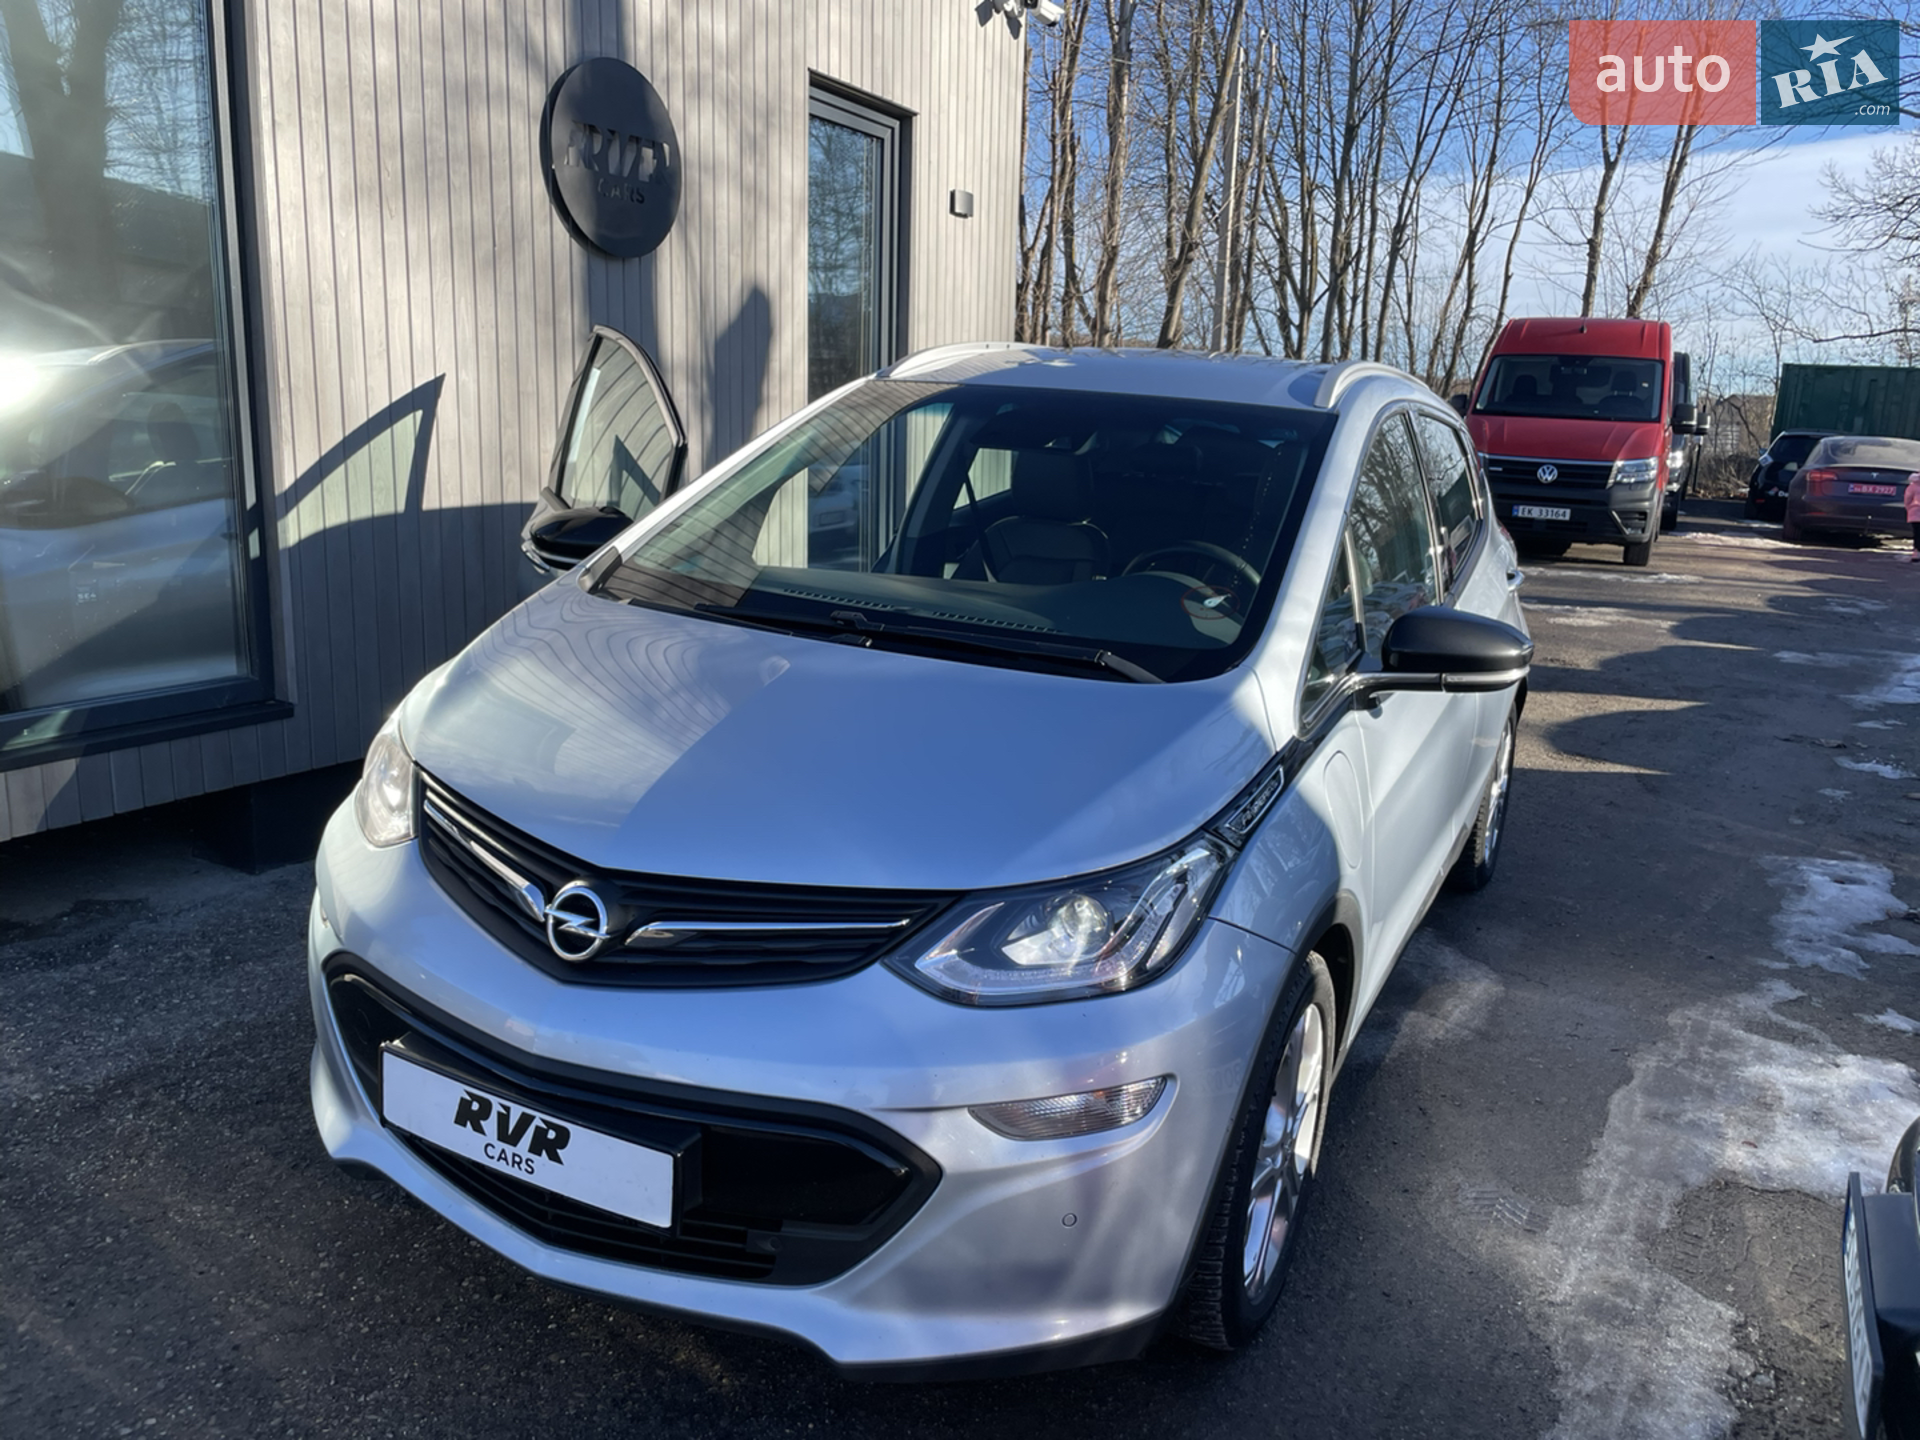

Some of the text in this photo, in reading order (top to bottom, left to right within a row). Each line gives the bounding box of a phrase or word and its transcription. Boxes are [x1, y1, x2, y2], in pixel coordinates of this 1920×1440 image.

[598, 178, 645, 204] CARS
[1521, 506, 1534, 516] EK
[1538, 508, 1567, 518] 33164
[453, 1089, 571, 1165] RVR
[483, 1142, 536, 1175] CARS
